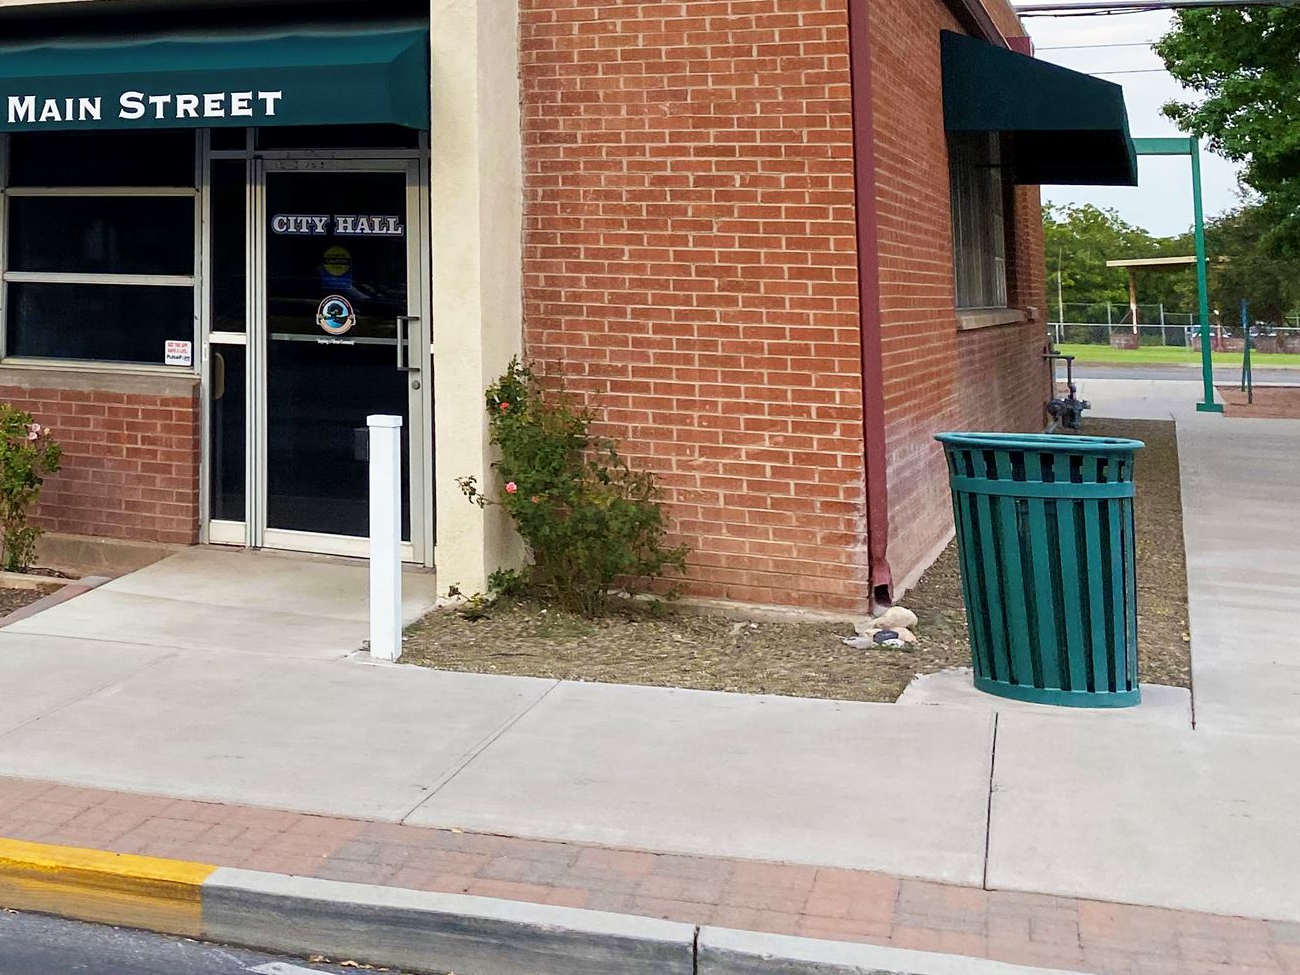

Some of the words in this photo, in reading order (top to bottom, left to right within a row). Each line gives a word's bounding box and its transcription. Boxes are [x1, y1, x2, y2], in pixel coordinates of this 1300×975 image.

[7, 94, 102, 124] MAIN
[118, 89, 283, 120] STREET
[272, 214, 329, 234] CITY
[334, 215, 404, 236] HALL
